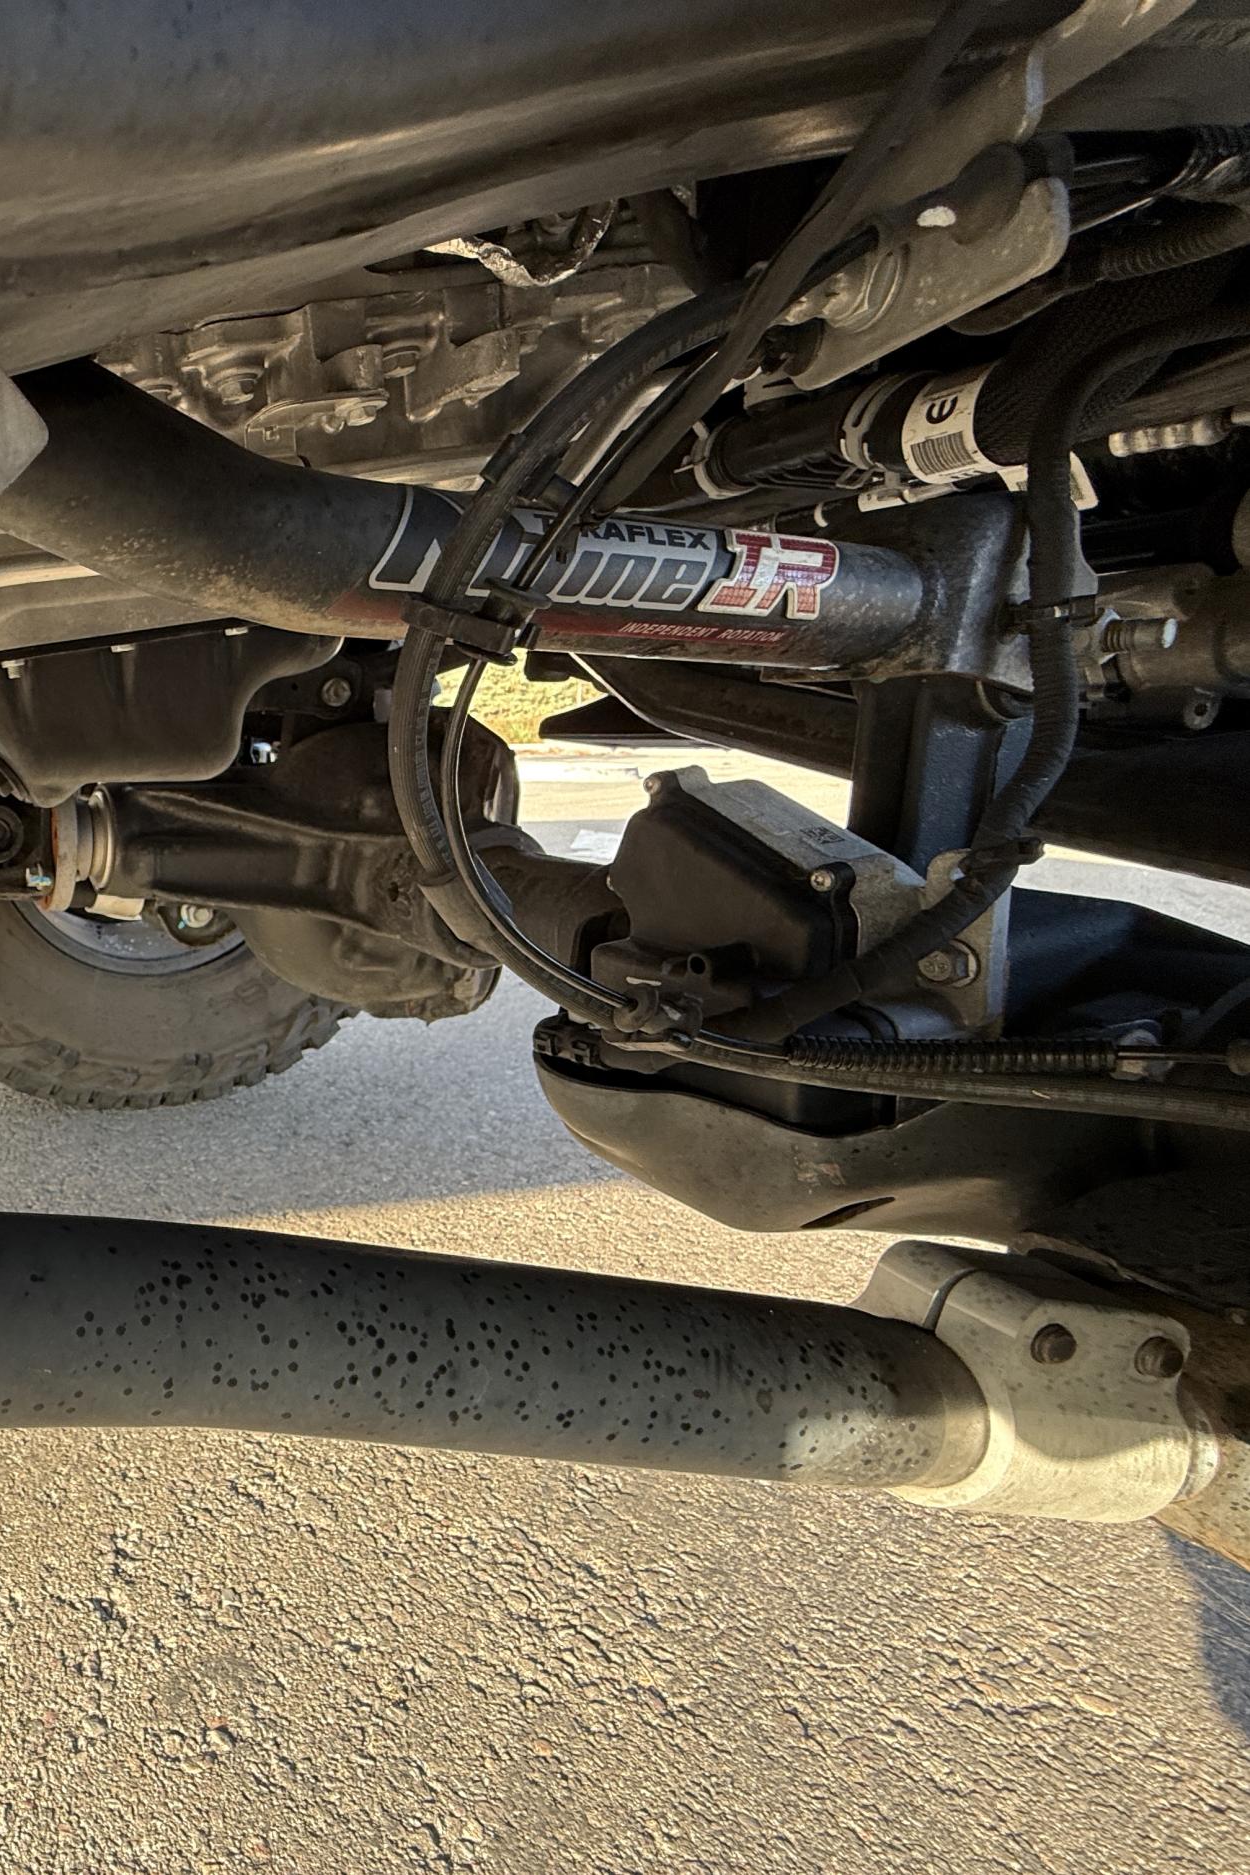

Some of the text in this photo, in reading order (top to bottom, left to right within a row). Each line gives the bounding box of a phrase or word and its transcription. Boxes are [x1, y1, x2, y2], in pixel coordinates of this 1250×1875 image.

[534, 513, 711, 551] TRAFLEX
[618, 622, 786, 642] INDEPENDENT ROTATION
